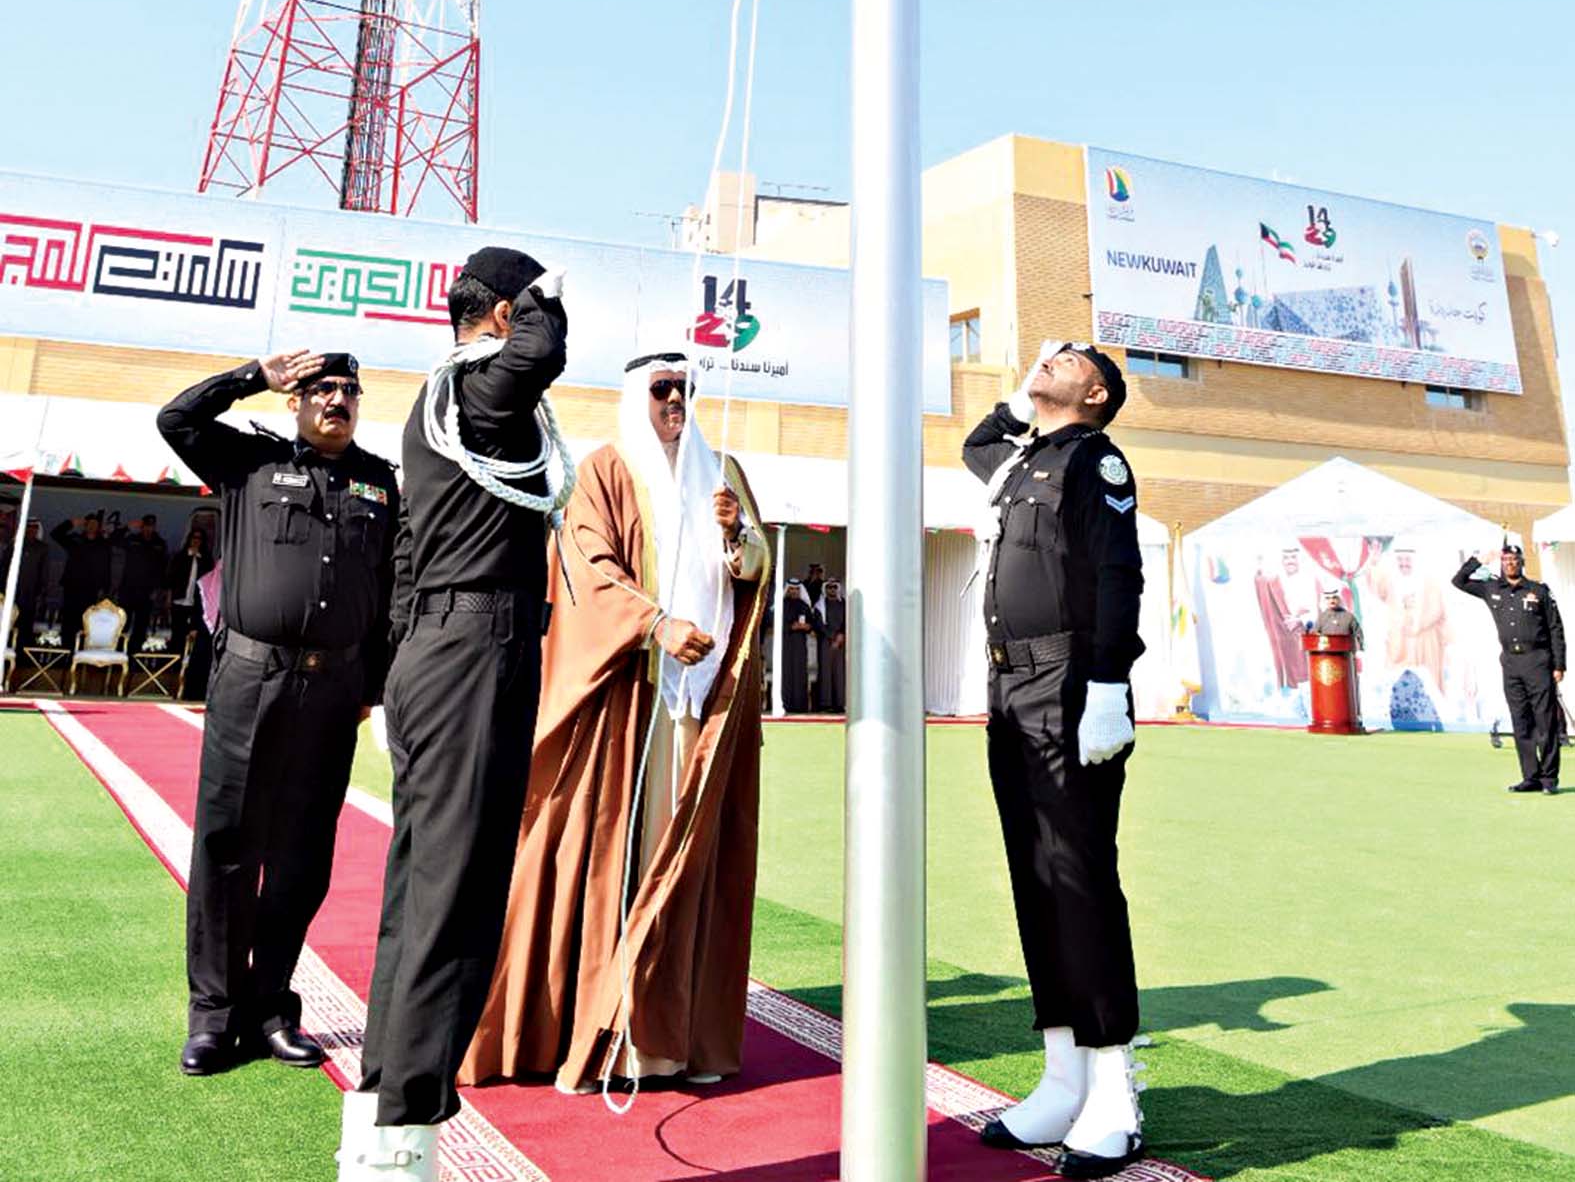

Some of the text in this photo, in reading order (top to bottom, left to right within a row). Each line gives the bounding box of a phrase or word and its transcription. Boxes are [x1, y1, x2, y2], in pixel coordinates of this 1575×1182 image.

[1106, 249, 1197, 278] NEWKUWAIT
[288, 248, 423, 316] الكويت
[702, 274, 752, 315] 14
[730, 358, 761, 373] سندنا
[762, 358, 789, 377] أميرنا
